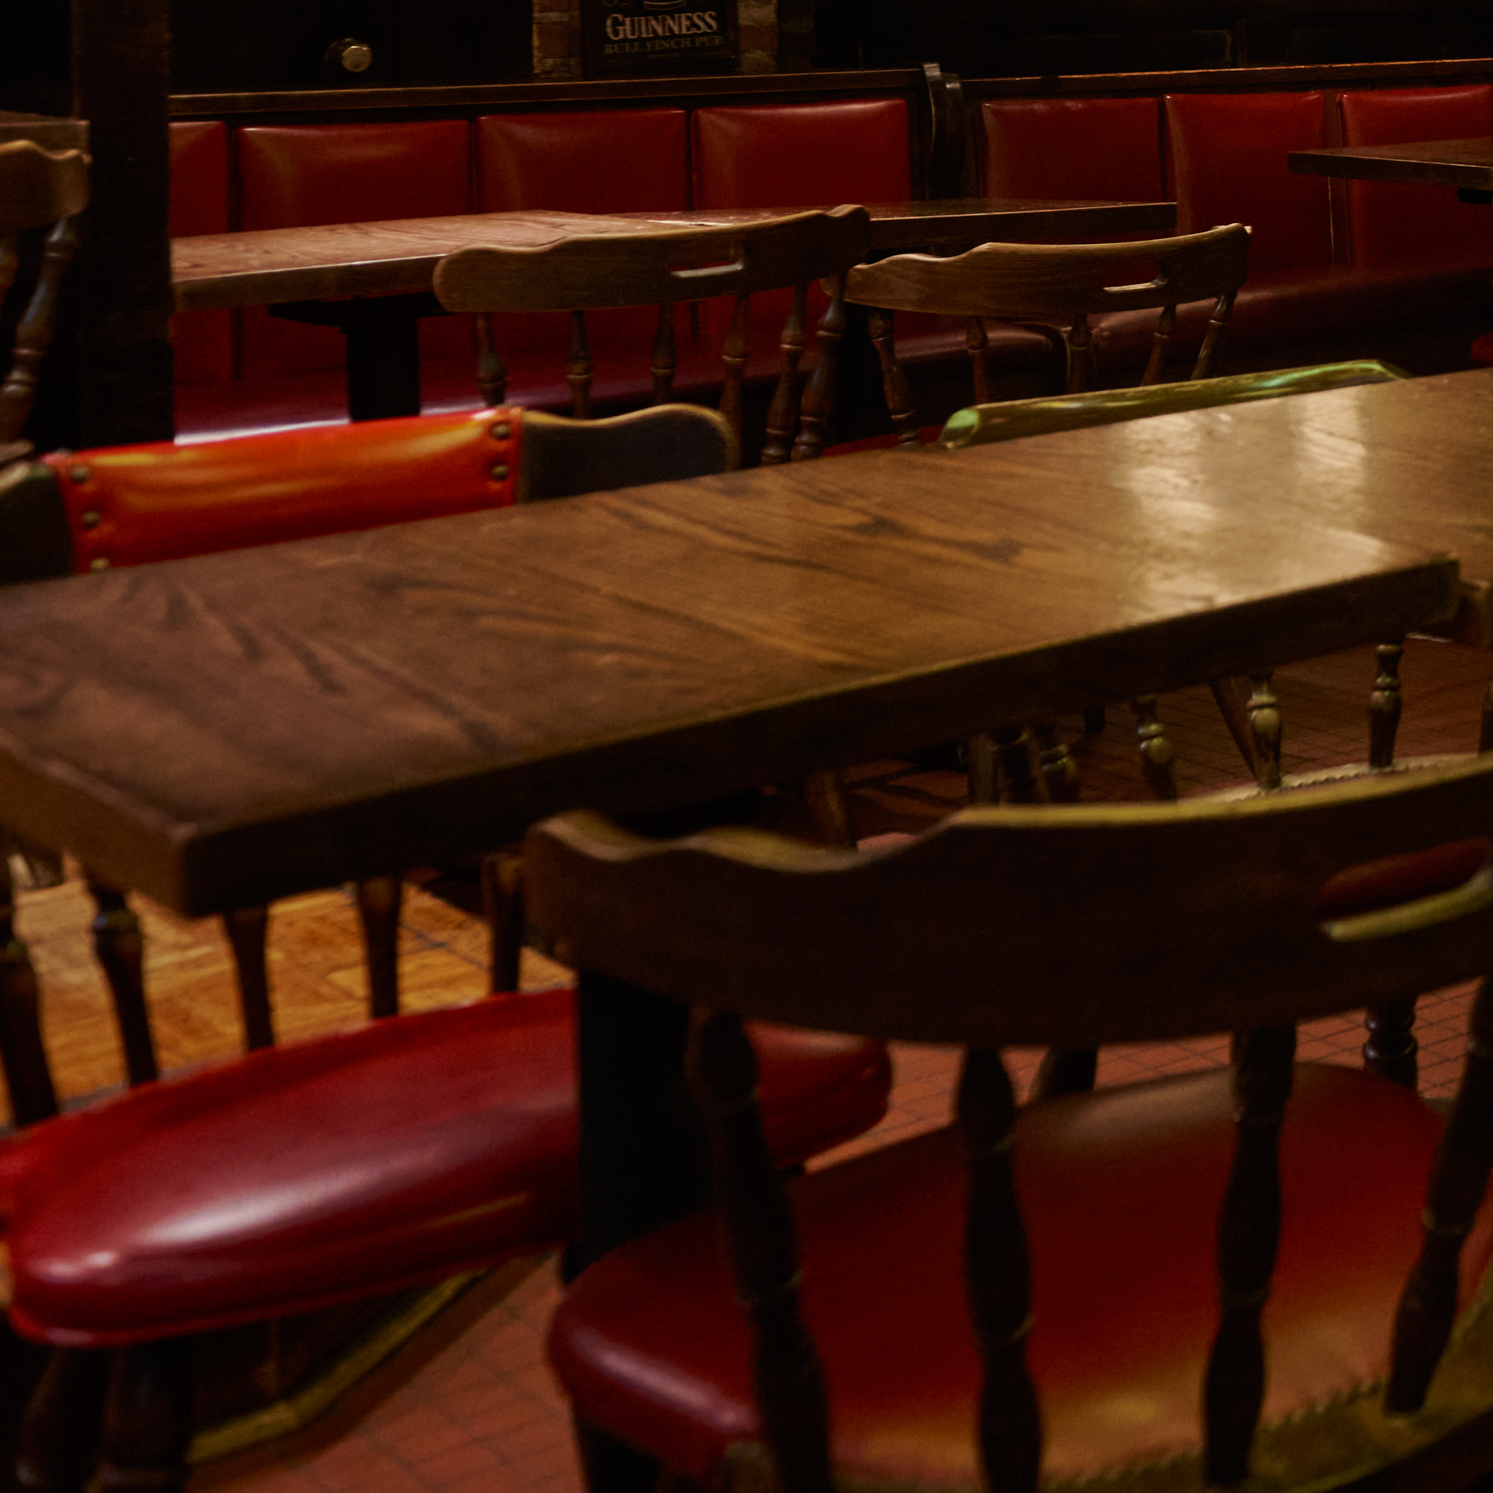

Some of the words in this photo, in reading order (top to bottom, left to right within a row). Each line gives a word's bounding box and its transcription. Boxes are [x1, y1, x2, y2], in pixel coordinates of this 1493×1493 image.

[605, 10, 718, 41] GUINNESS
[603, 40, 643, 55] BULL
[647, 36, 692, 52] FINCH
[694, 34, 725, 47] PUB
